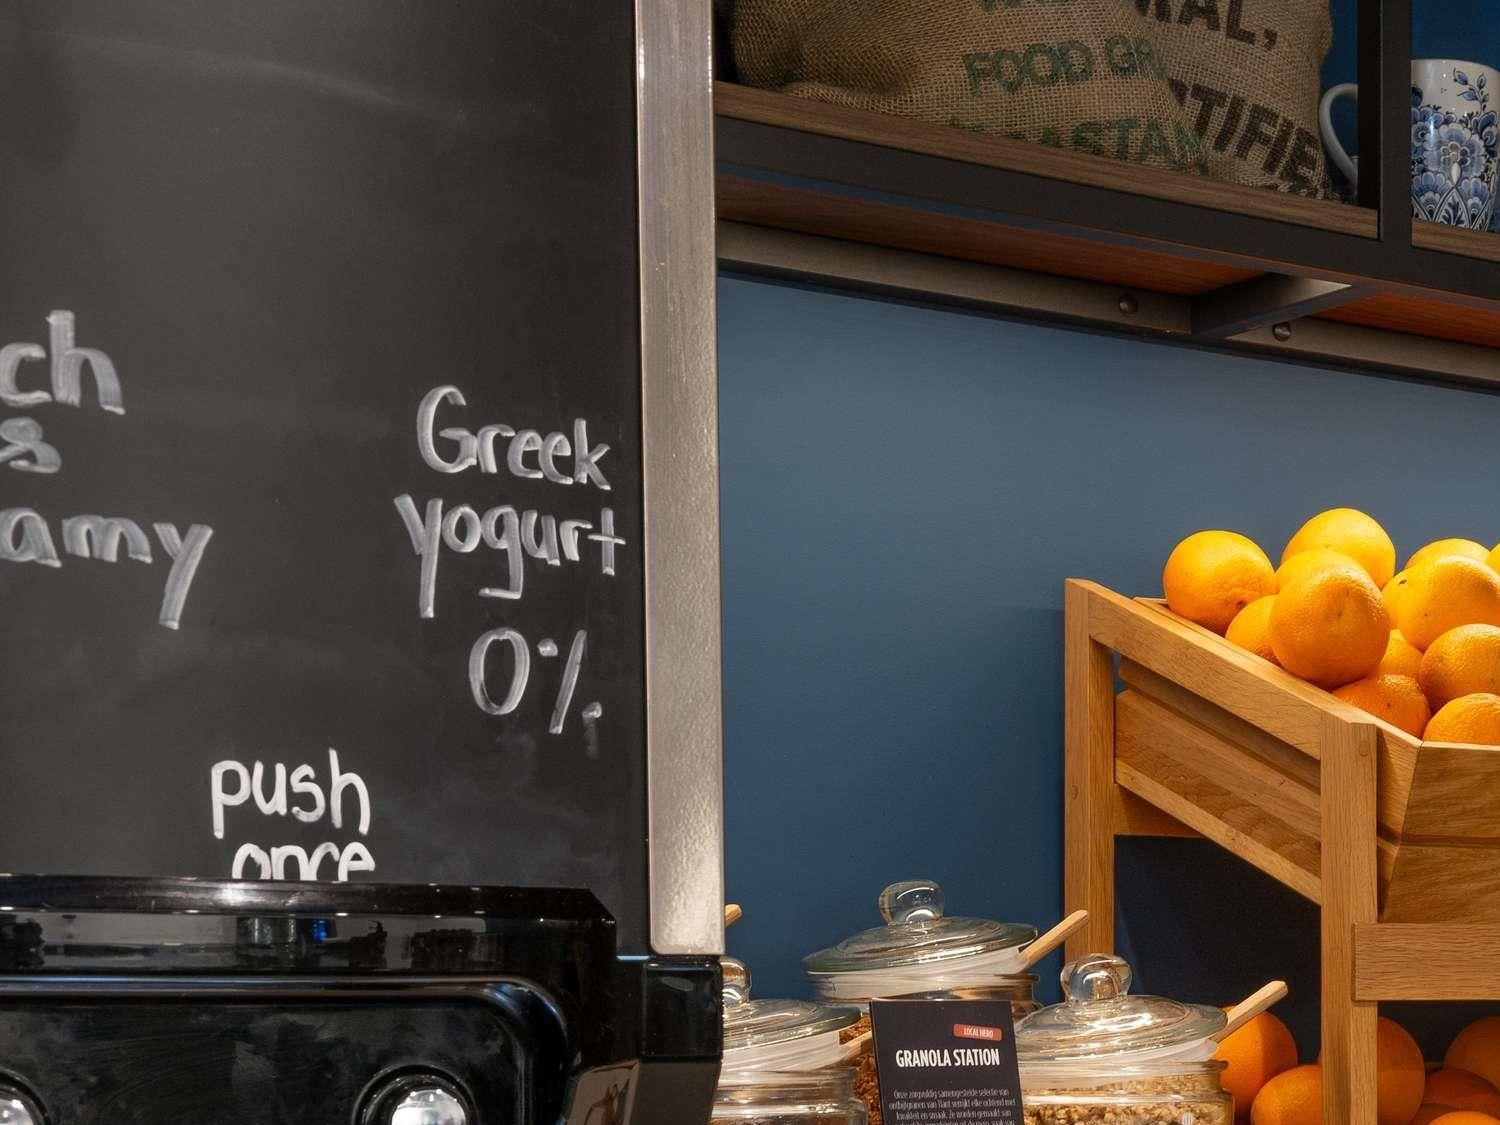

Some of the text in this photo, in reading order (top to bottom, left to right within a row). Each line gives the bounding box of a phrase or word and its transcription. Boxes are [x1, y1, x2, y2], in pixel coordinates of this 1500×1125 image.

[960, 39, 1094, 97] FOOD
[0, 310, 125, 415] ch
[416, 384, 612, 490] Greek
[0, 507, 214, 630] amy
[393, 493, 627, 619] yogurt
[468, 627, 602, 734] 0%
[211, 747, 371, 840] push
[231, 841, 376, 881] once
[895, 1048, 1000, 1068] GRANOLA STATION
[963, 1026, 994, 1038] LOCAL HERO
